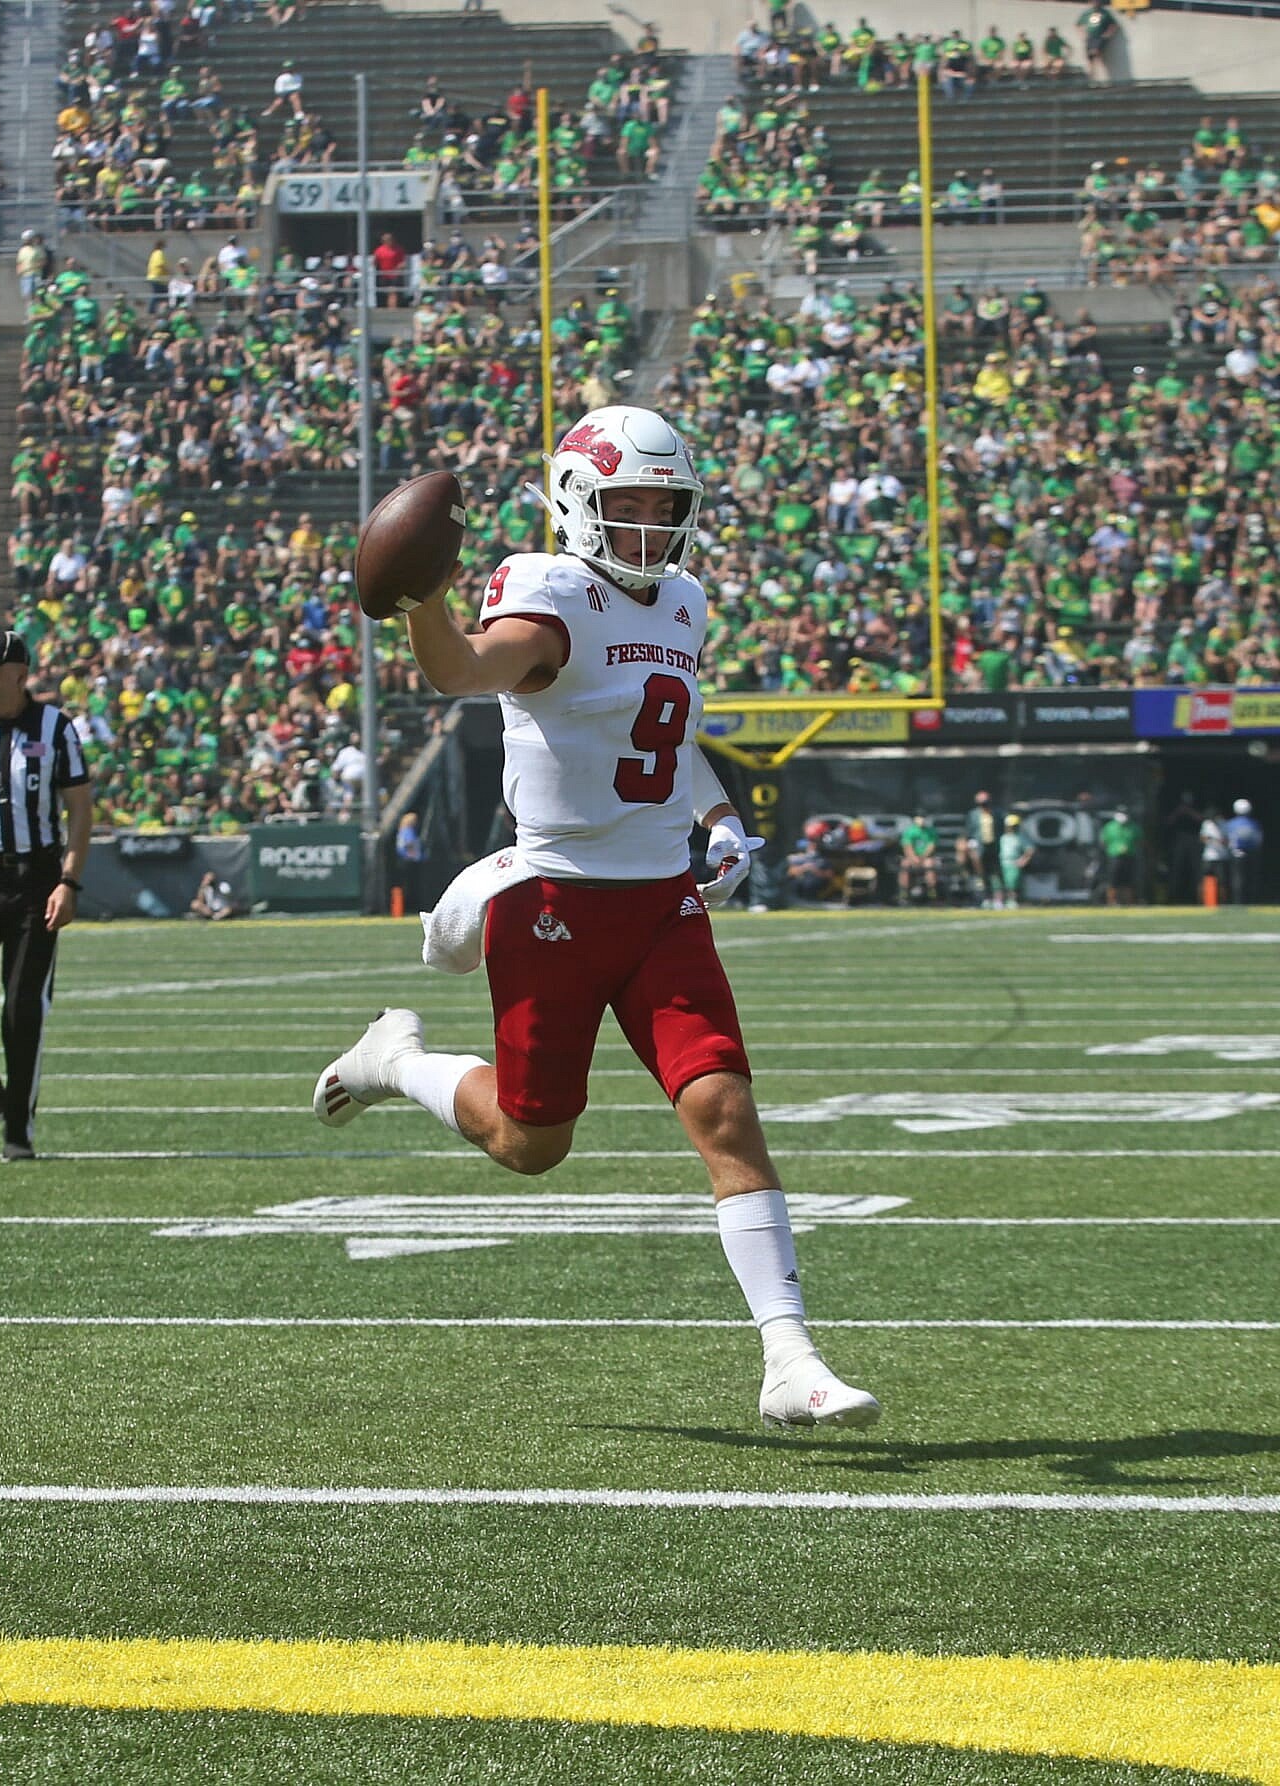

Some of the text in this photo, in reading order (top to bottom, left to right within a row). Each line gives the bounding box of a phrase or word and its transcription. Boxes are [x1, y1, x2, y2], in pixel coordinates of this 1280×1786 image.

[288, 182, 322, 207] 39
[395, 182, 409, 205] 1
[487, 565, 511, 608] 9
[606, 643, 664, 666] FRESNO
[613, 672, 691, 805] 9
[27, 773, 40, 791] C
[260, 845, 350, 867] ROCKET
